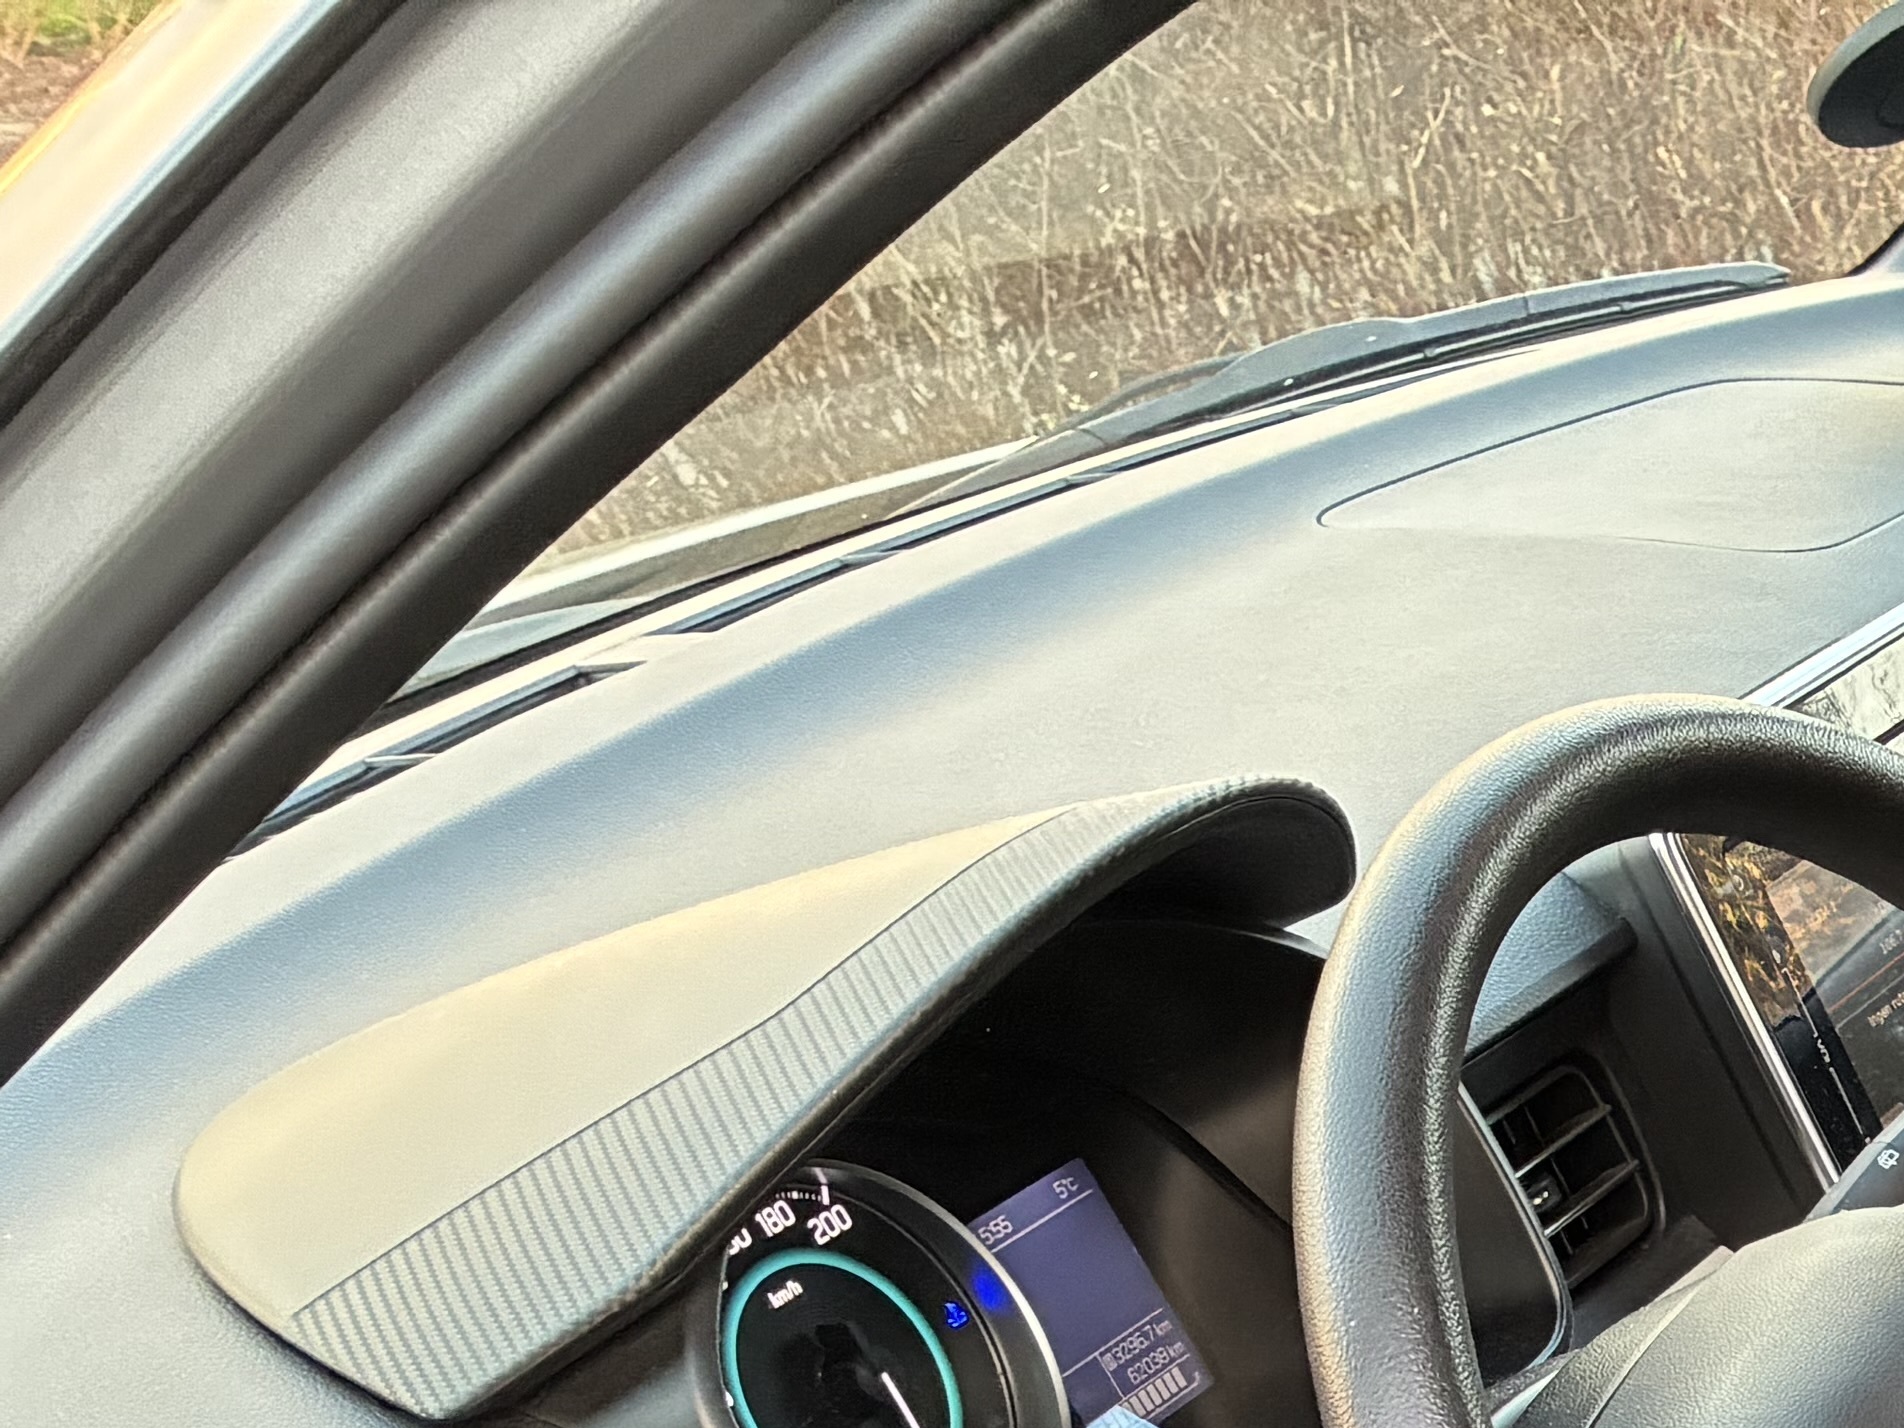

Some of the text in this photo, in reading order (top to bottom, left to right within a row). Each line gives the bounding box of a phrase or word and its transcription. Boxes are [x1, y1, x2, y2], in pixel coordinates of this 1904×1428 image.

[754, 1200, 796, 1237] 180
[807, 1204, 852, 1245] 200
[767, 1280, 803, 1309] km/h
